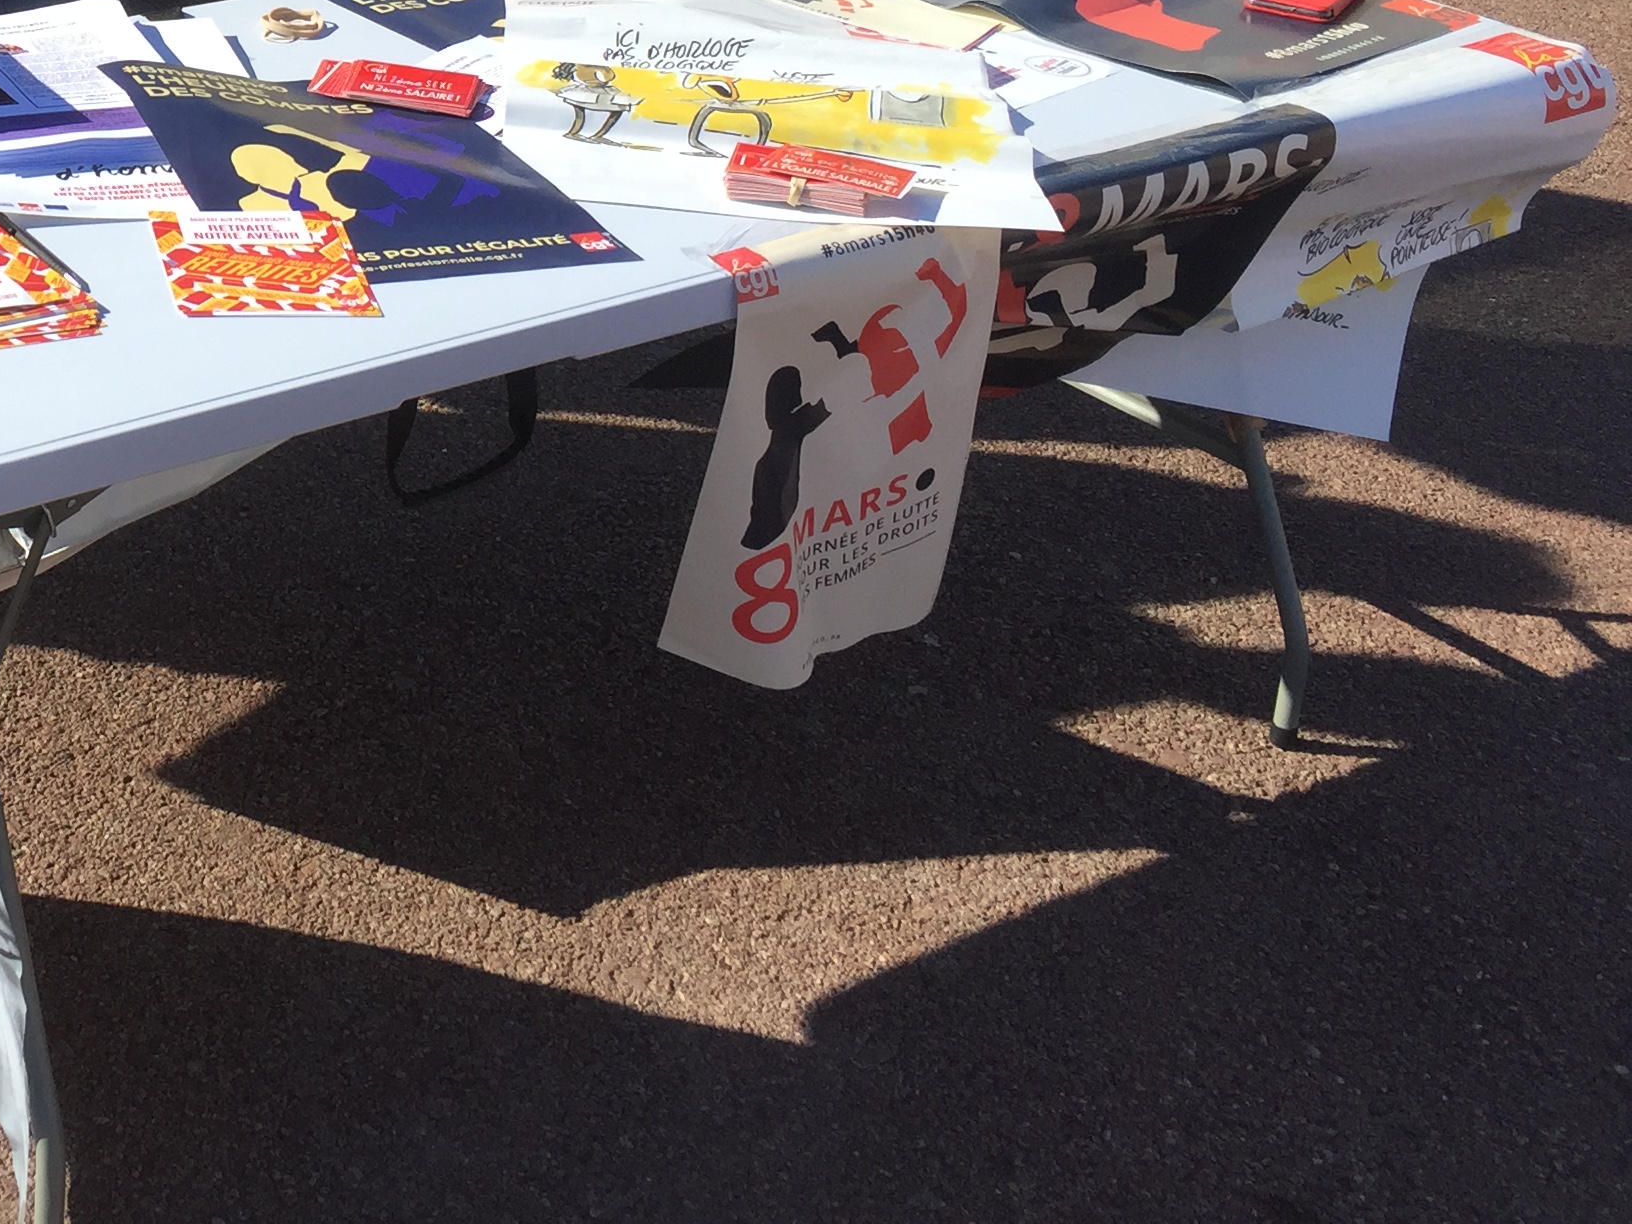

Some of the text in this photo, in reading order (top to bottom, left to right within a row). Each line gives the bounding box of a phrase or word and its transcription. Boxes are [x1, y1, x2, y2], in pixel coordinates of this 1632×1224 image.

[603, 47, 636, 61] PAS
[131, 74, 270, 98] L'HEURE
[359, 82, 374, 90] NI
[403, 88, 454, 102] SALAIRE
[424, 79, 454, 91] SEXE
[1533, 53, 1613, 110] cgt
[143, 86, 374, 114] DES COMPTES
[193, 231, 301, 240] NOTRE AVENIR
[382, 244, 455, 261] POUR
[455, 233, 572, 254] L'ÉGALITÉ
[579, 239, 615, 252] cgt
[181, 255, 328, 283] RETRAITES
[734, 265, 780, 297] cgt
[797, 491, 940, 572] OURNÉE DE LUTTE
[799, 509, 939, 585] OUR LES DROITS
[814, 552, 877, 591] FEMMES
[731, 542, 799, 644] 8
